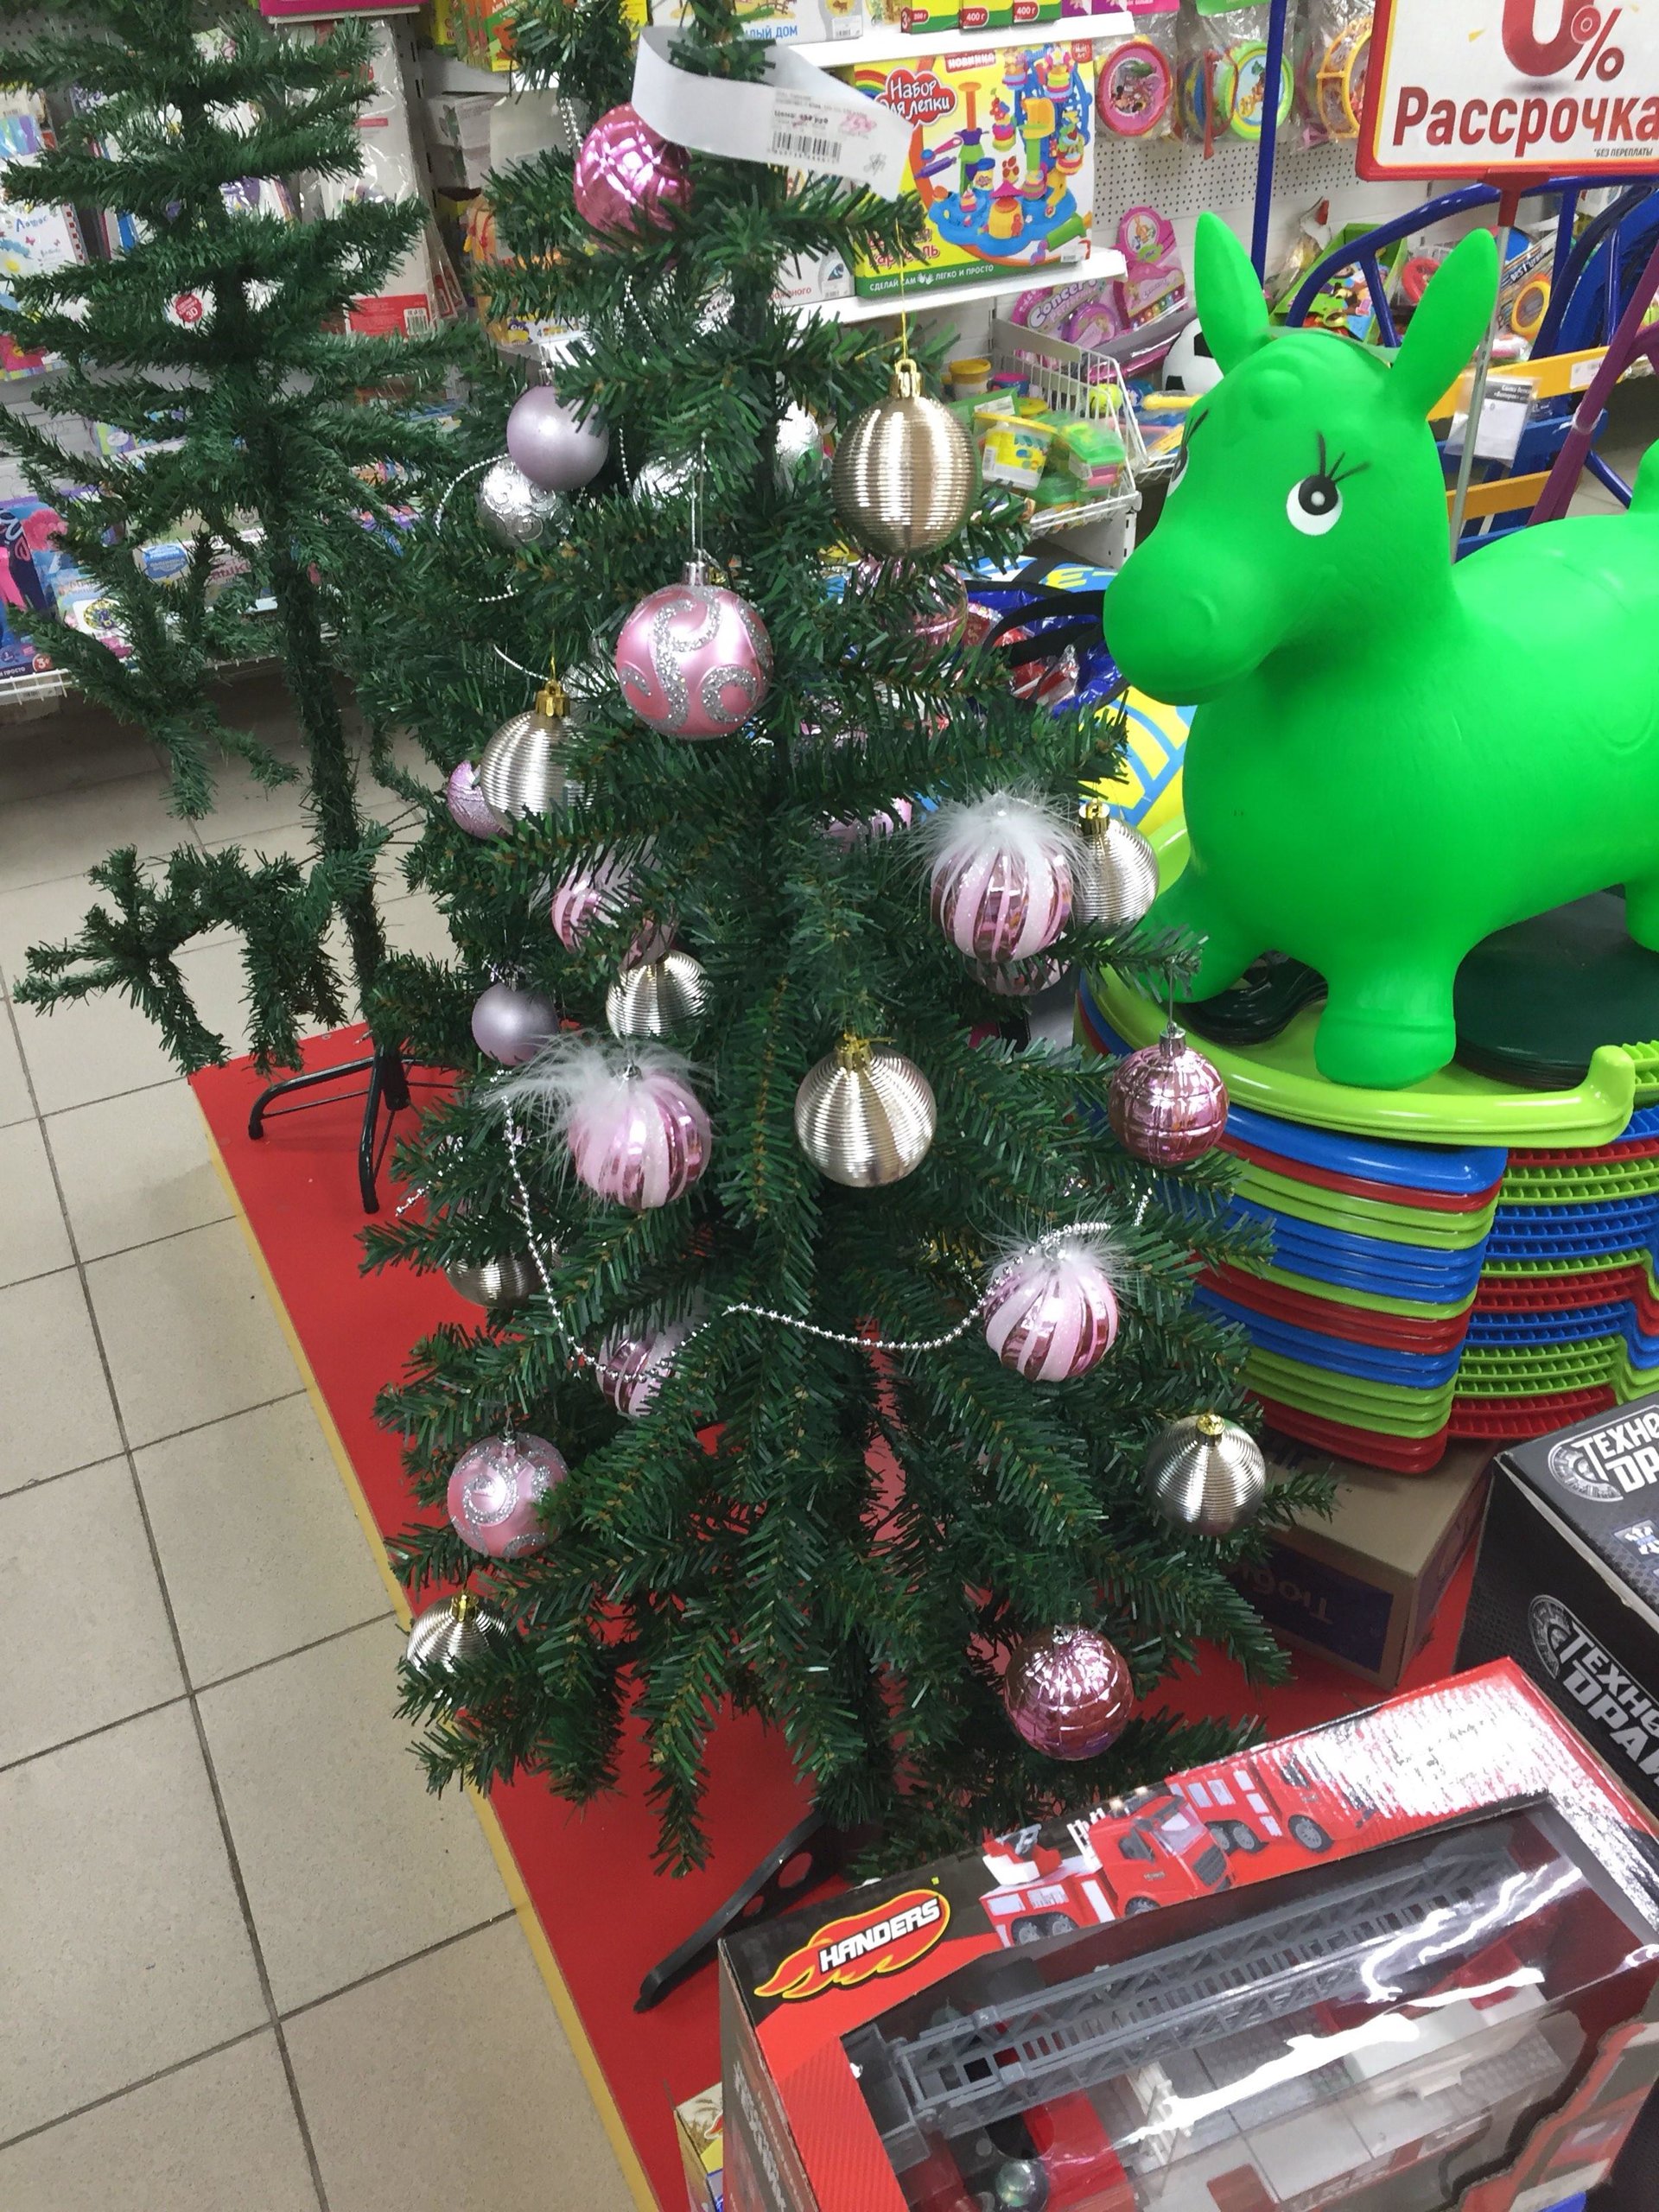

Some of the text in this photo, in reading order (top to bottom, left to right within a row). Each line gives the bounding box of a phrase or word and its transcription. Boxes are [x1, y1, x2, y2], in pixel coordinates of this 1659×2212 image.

[966, 13, 980, 22] 400
[948, 52, 995, 69] НОВИНКА
[890, 77, 937, 100] Набор
[906, 97, 950, 120] лепки
[1393, 86, 1659, 157] Рассрочка
[1611, 147, 1653, 157] ПЕРЕПЛАТЫ
[869, 279, 899, 292] СДЕЛАЙ
[936, 270, 957, 282] ЛЕГКО
[958, 269, 964, 277] И
[966, 264, 994, 276] ПРОСТО
[186, 307, 198, 320] 3D
[819, 1898, 939, 1973] HANDERS
